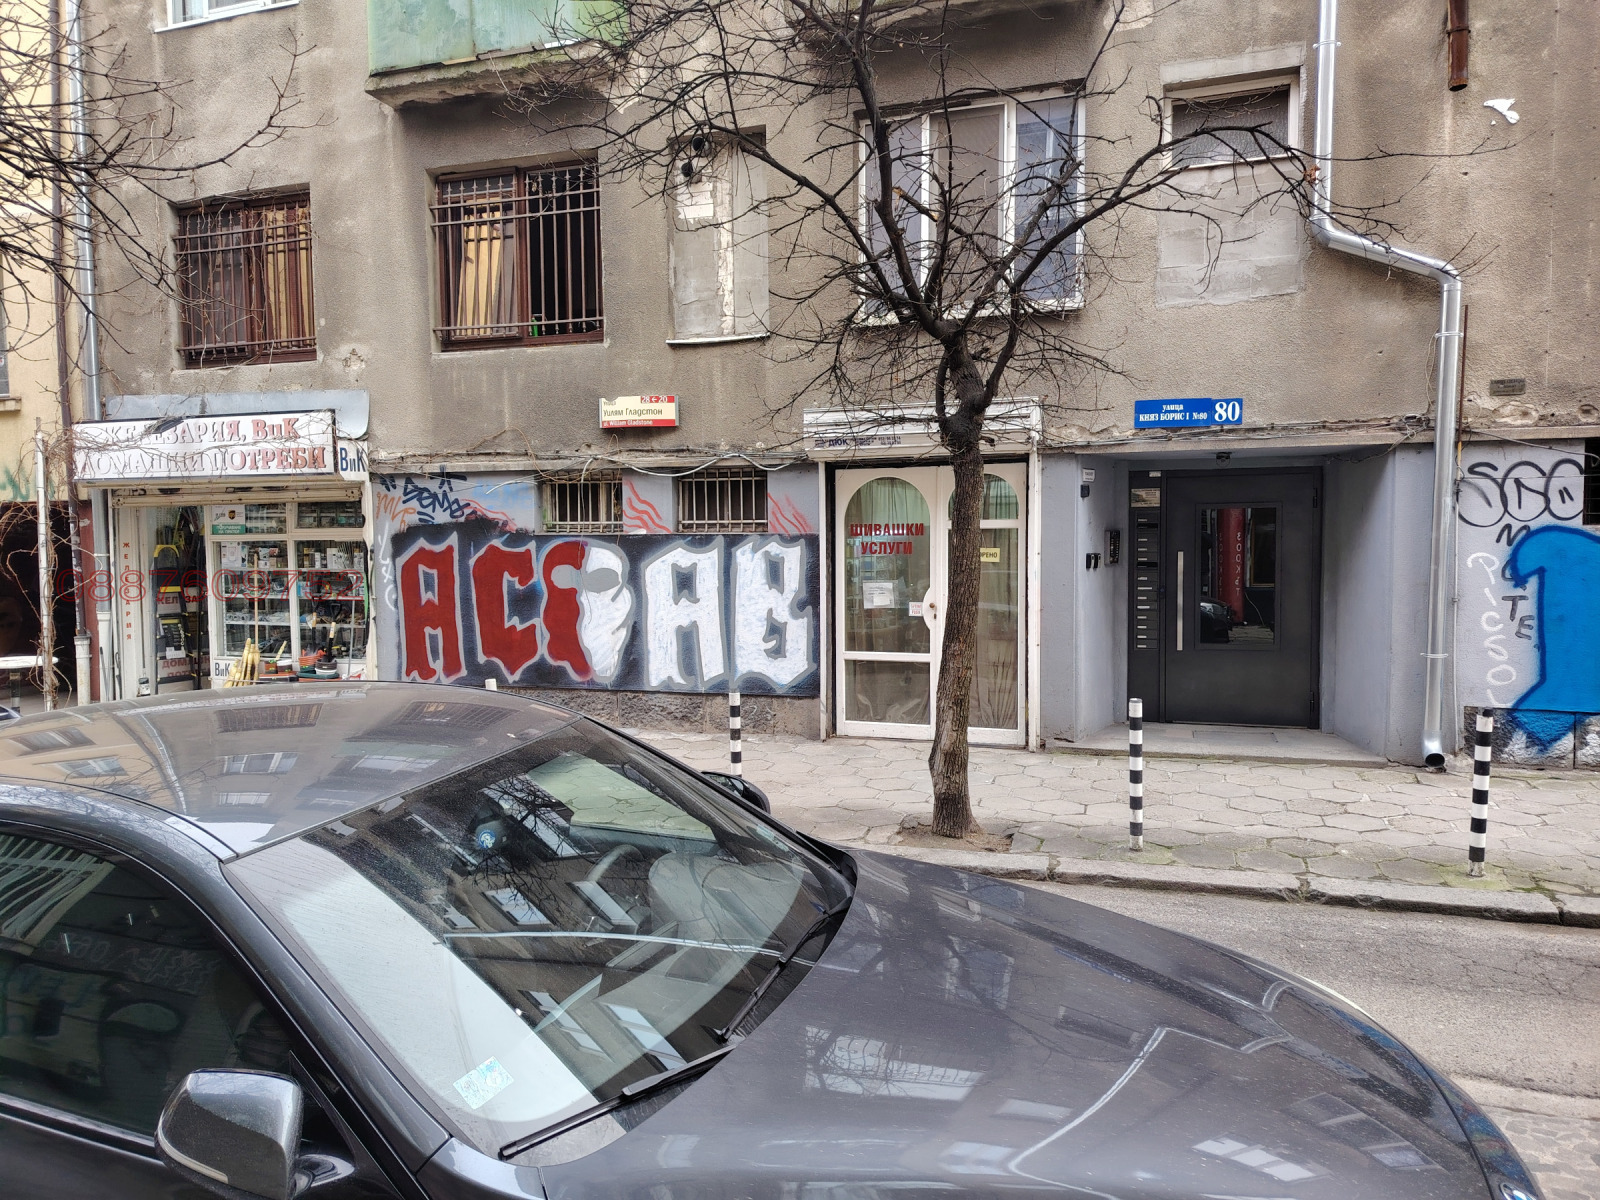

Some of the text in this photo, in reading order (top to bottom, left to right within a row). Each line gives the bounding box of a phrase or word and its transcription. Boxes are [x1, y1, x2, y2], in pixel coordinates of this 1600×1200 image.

[625, 408, 663, 417] Гладстон
[1162, 404, 1184, 412] улица
[1214, 401, 1240, 421] 80
[1139, 413, 1159, 421] КНЯЗ
[1160, 412, 1185, 421] БОРИС
[1186, 412, 1190, 420] I
[103, 417, 300, 445] ЖЕЕЗАРИЯ, ВиК
[208, 446, 327, 472] ПОТРЕБИ
[340, 447, 367, 473] ВиК
[850, 523, 925, 537] ШИВАШКИ
[861, 541, 913, 555] УСЛУГИ
[214, 662, 231, 677] ВиК
